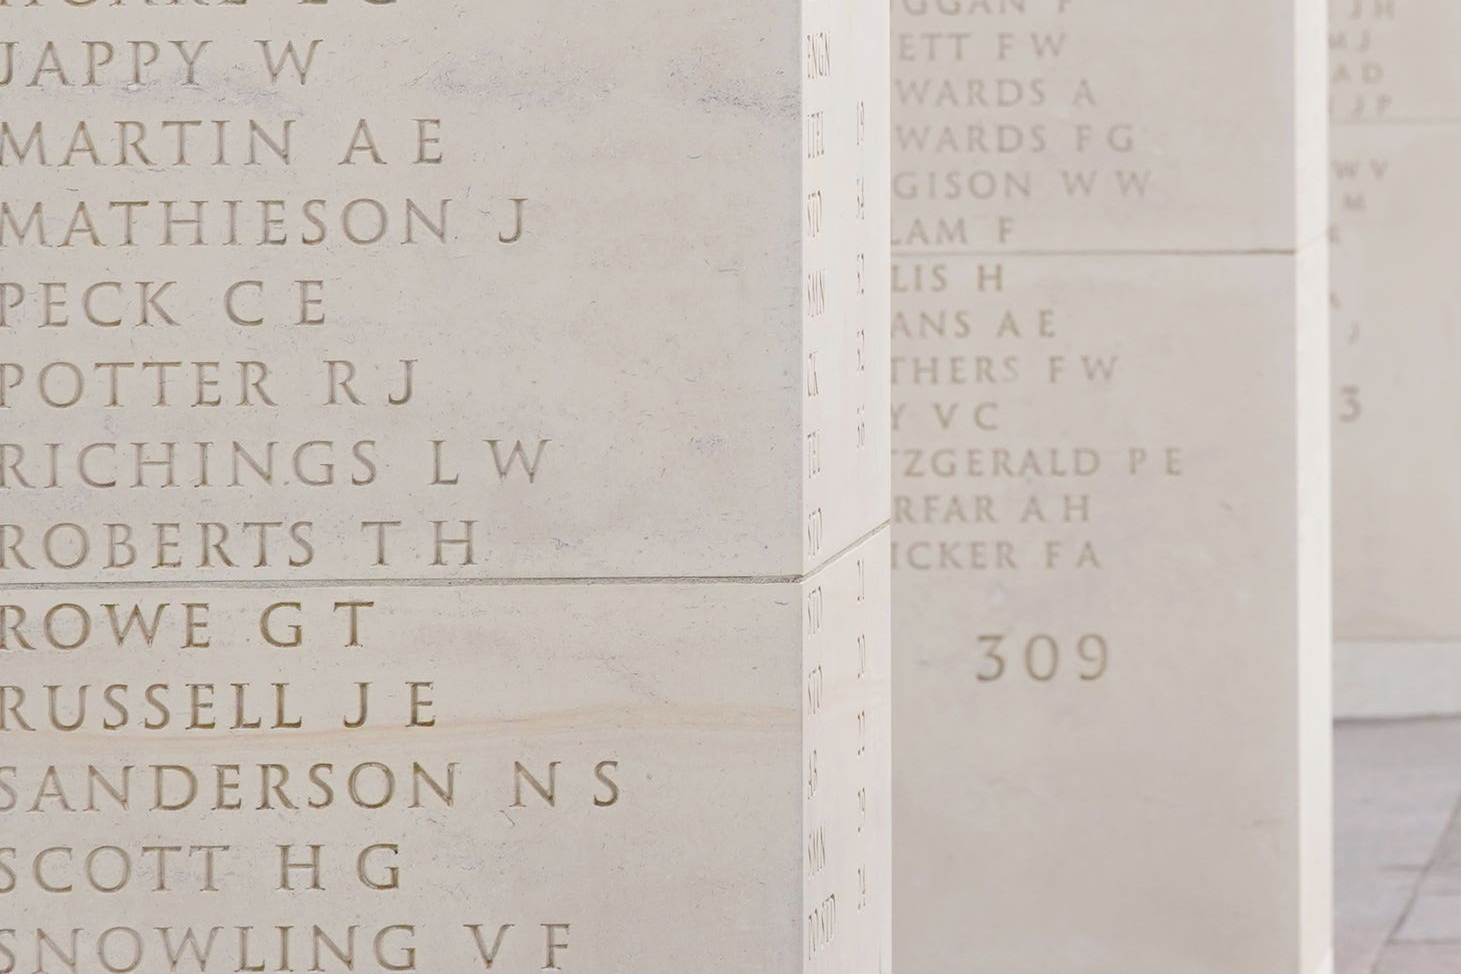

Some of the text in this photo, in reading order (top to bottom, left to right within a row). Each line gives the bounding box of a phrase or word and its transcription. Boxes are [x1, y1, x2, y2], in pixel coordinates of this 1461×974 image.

[0, 39, 323, 87] JAPPY W
[0, 118, 443, 167] MARTIN A E
[1076, 124, 1093, 153] F
[1106, 123, 1134, 153] G
[1060, 170, 1097, 197] W
[1114, 169, 1151, 197] W
[0, 198, 528, 248] MATHIESON J
[977, 263, 1003, 293] H
[0, 280, 325, 328] PECK C E
[996, 309, 1022, 339] A
[1037, 308, 1056, 339] E
[0, 359, 418, 408] POTTER R J
[1048, 355, 1065, 385] F
[1080, 355, 1119, 383] W
[0, 439, 551, 489] RICHINGS L W
[891, 447, 1183, 478] ZGERALD P E
[1020, 493, 1047, 524] A
[1063, 493, 1090, 523] H
[0, 520, 477, 570] ROBERTS T H
[0, 600, 375, 650] ROWE G T
[977, 634, 1108, 683] 309
[0, 681, 436, 732] RUSSELL J E
[0, 760, 619, 812] SANDERSON N S
[0, 843, 399, 894] SCOTT H G
[0, 923, 570, 974] SNOWLING V F
